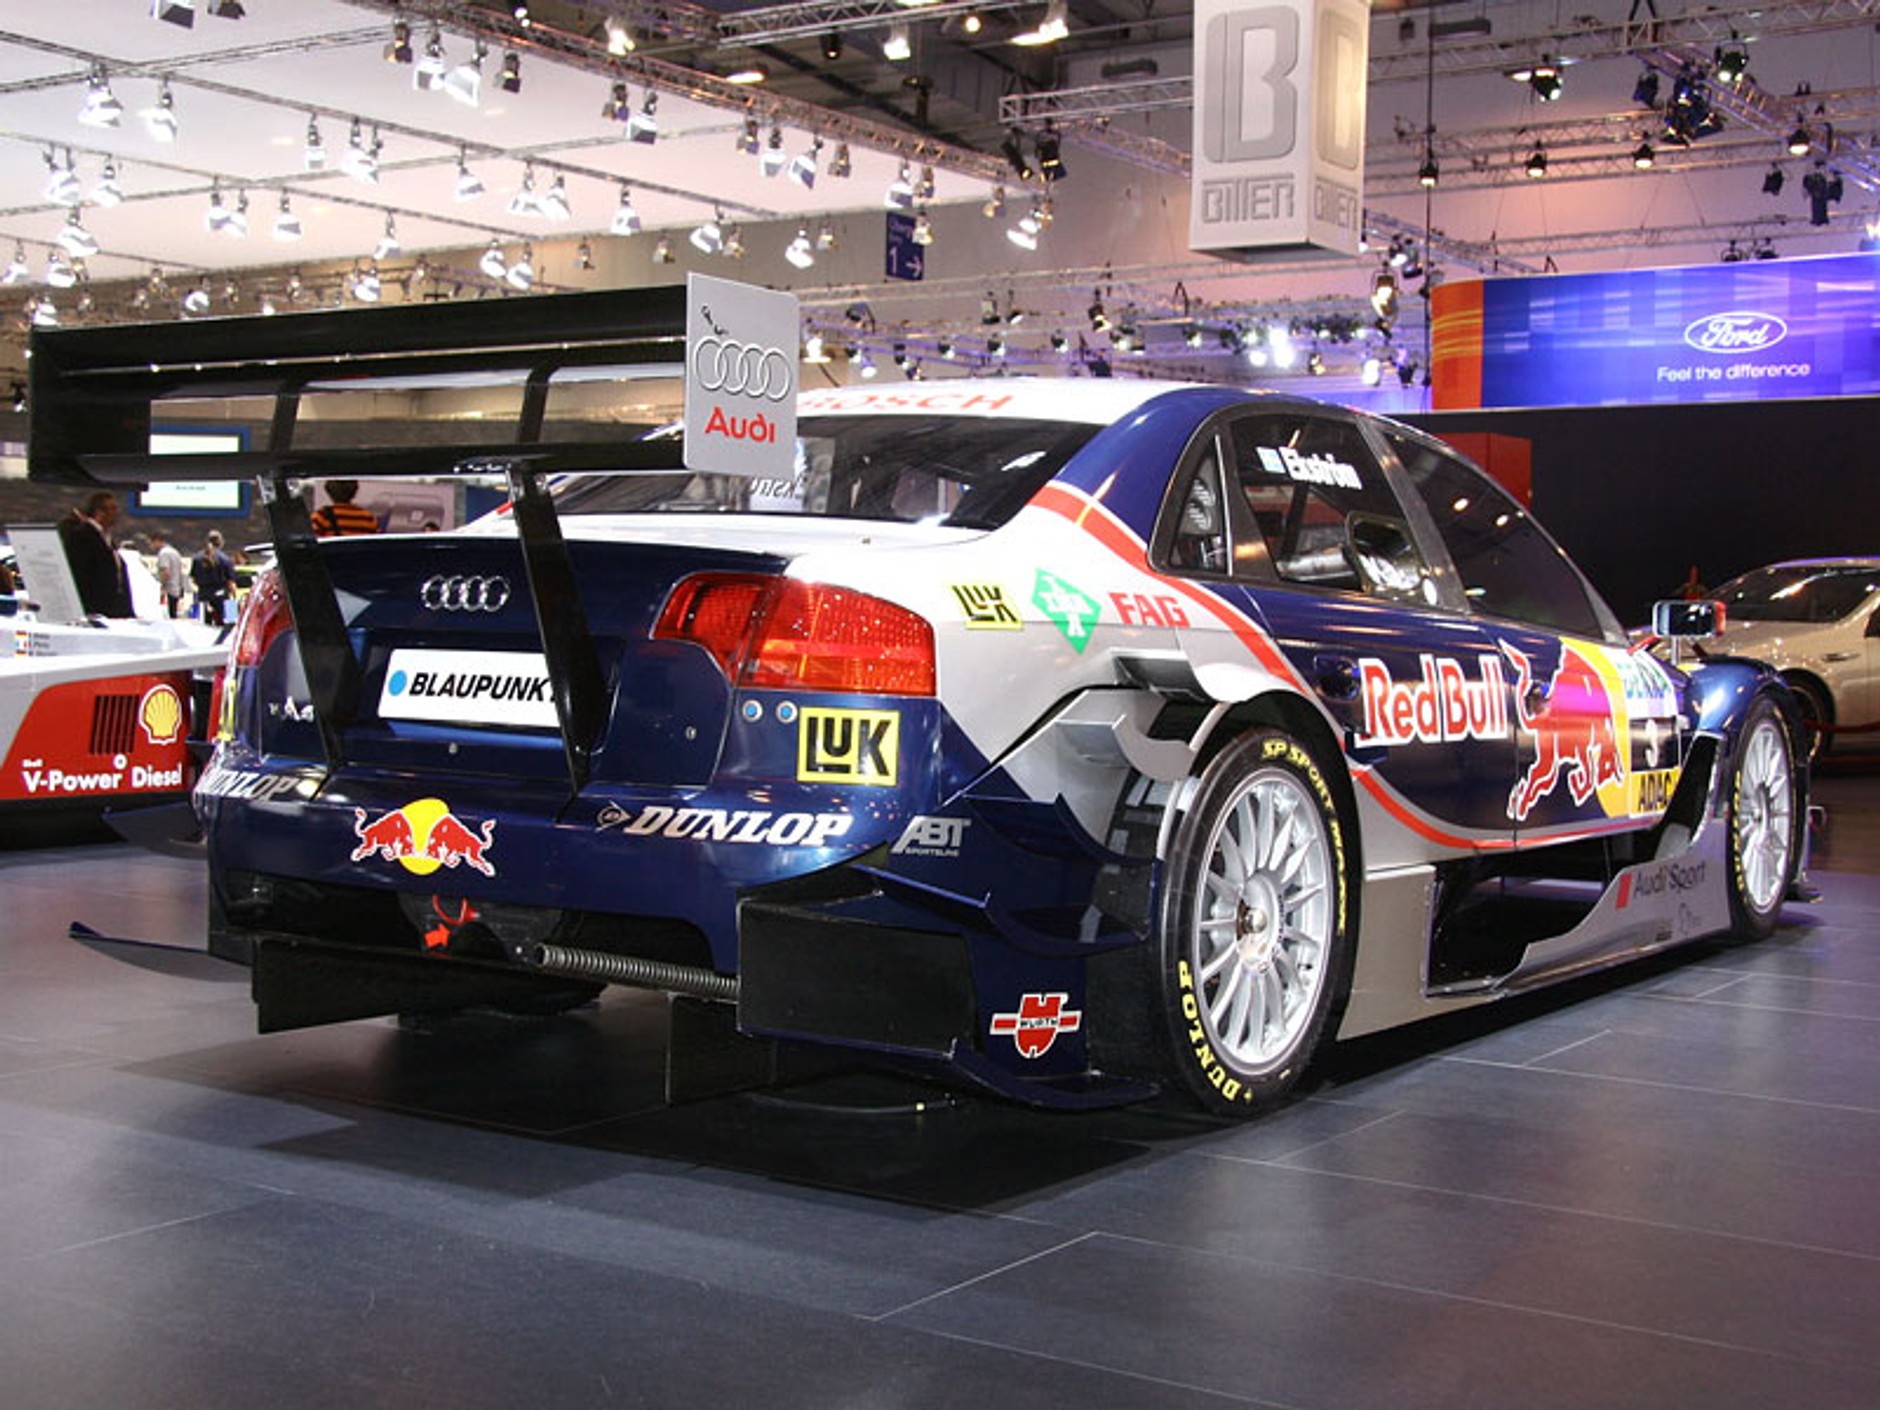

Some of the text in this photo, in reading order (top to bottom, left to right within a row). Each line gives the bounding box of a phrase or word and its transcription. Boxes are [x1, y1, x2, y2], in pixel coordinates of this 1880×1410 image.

[1701, 317, 1770, 347] Ford
[1656, 363, 1811, 382] Feel the difference
[704, 406, 776, 444] Audi
[1108, 592, 1190, 628] FAG
[1362, 657, 1504, 739] Red Bull
[22, 763, 182, 793] V-Power Diesel
[624, 805, 853, 845] DUNLOP
[891, 815, 972, 854] ABT
[1178, 960, 1242, 1101] DUNLOP
